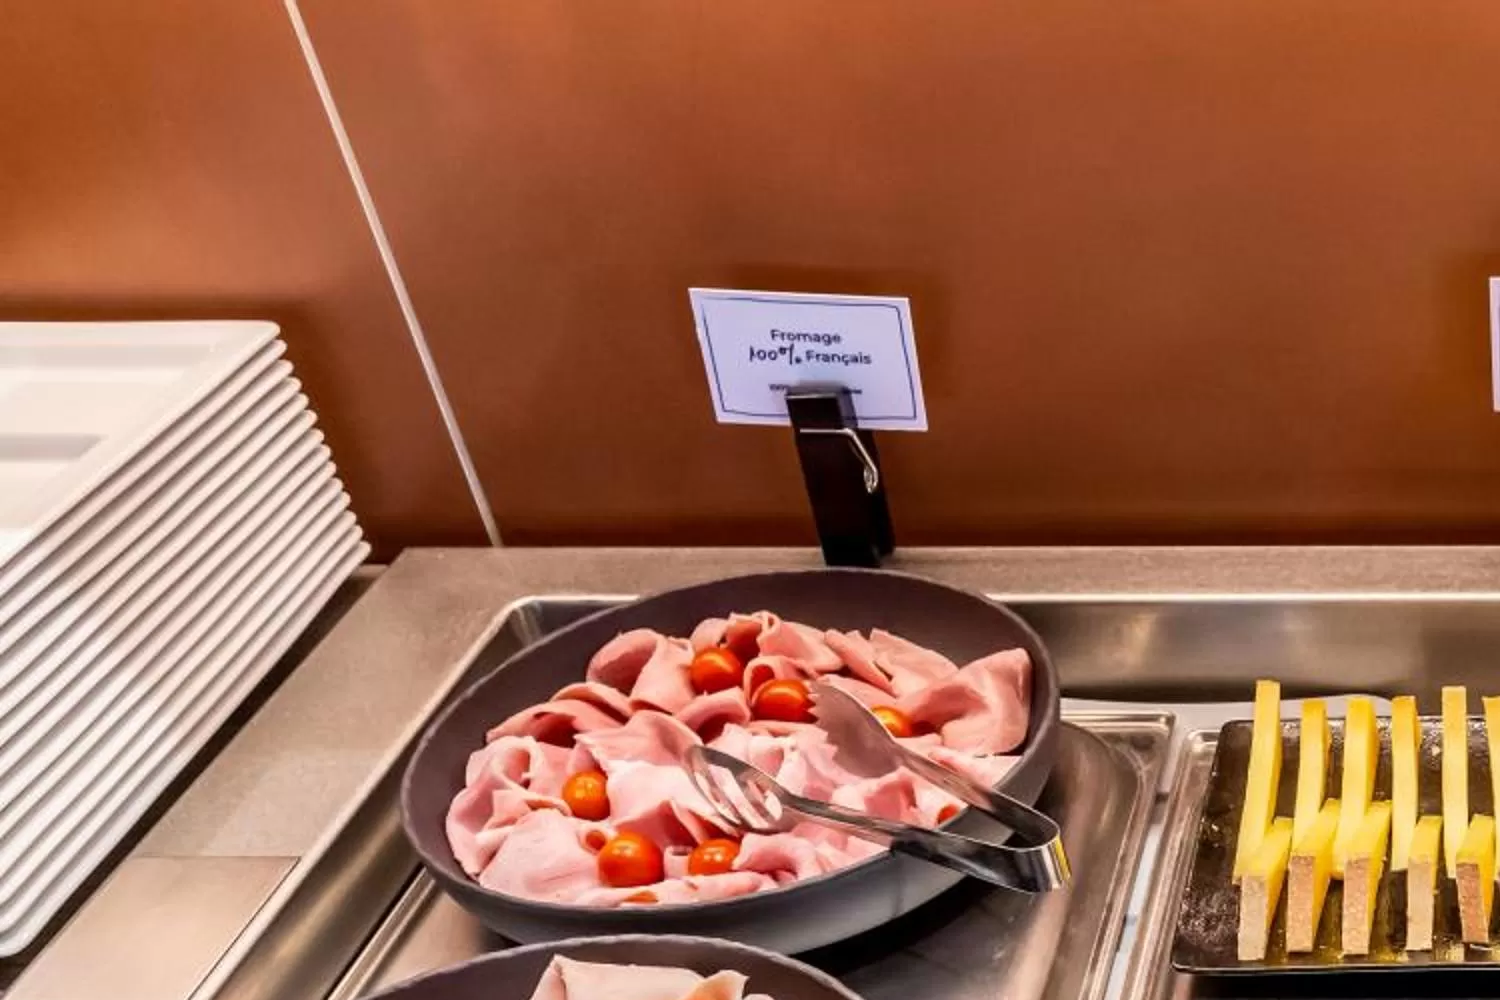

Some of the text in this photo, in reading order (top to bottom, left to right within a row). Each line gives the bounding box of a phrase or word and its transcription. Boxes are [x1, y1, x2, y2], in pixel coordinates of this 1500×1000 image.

[770, 328, 842, 346] Fromage
[749, 344, 872, 366] 100% Français
